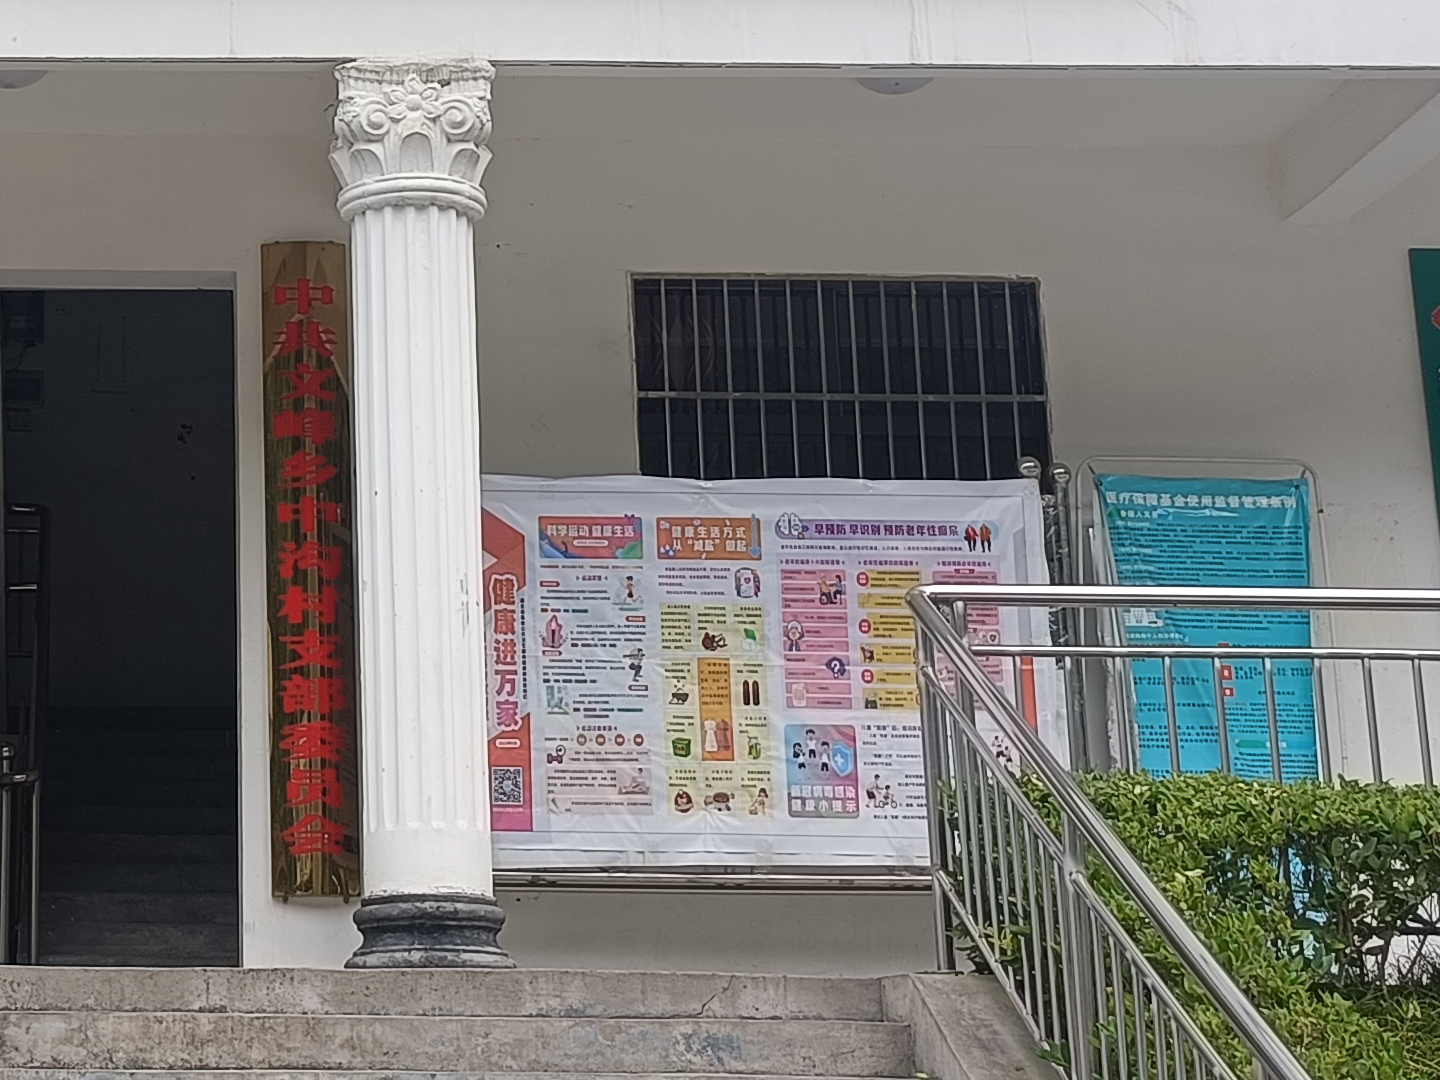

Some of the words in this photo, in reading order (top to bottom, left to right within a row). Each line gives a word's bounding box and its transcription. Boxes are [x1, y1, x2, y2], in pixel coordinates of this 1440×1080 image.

[1105, 491, 1297, 509] 医疗保障基金使用监督管理条例
[546, 524, 591, 538] 科学运动
[591, 524, 635, 538] 健康生活
[671, 525, 747, 539] 健康生活方式
[814, 523, 847, 537] 早预防
[849, 523, 881, 537] 早识别
[883, 524, 959, 537] 预防老年性痴呆
[272, 277, 348, 856] 中共文峰乡中沟村支部委员会
[493, 577, 521, 729] 健康进万家
[791, 799, 857, 813] 健康小提示
